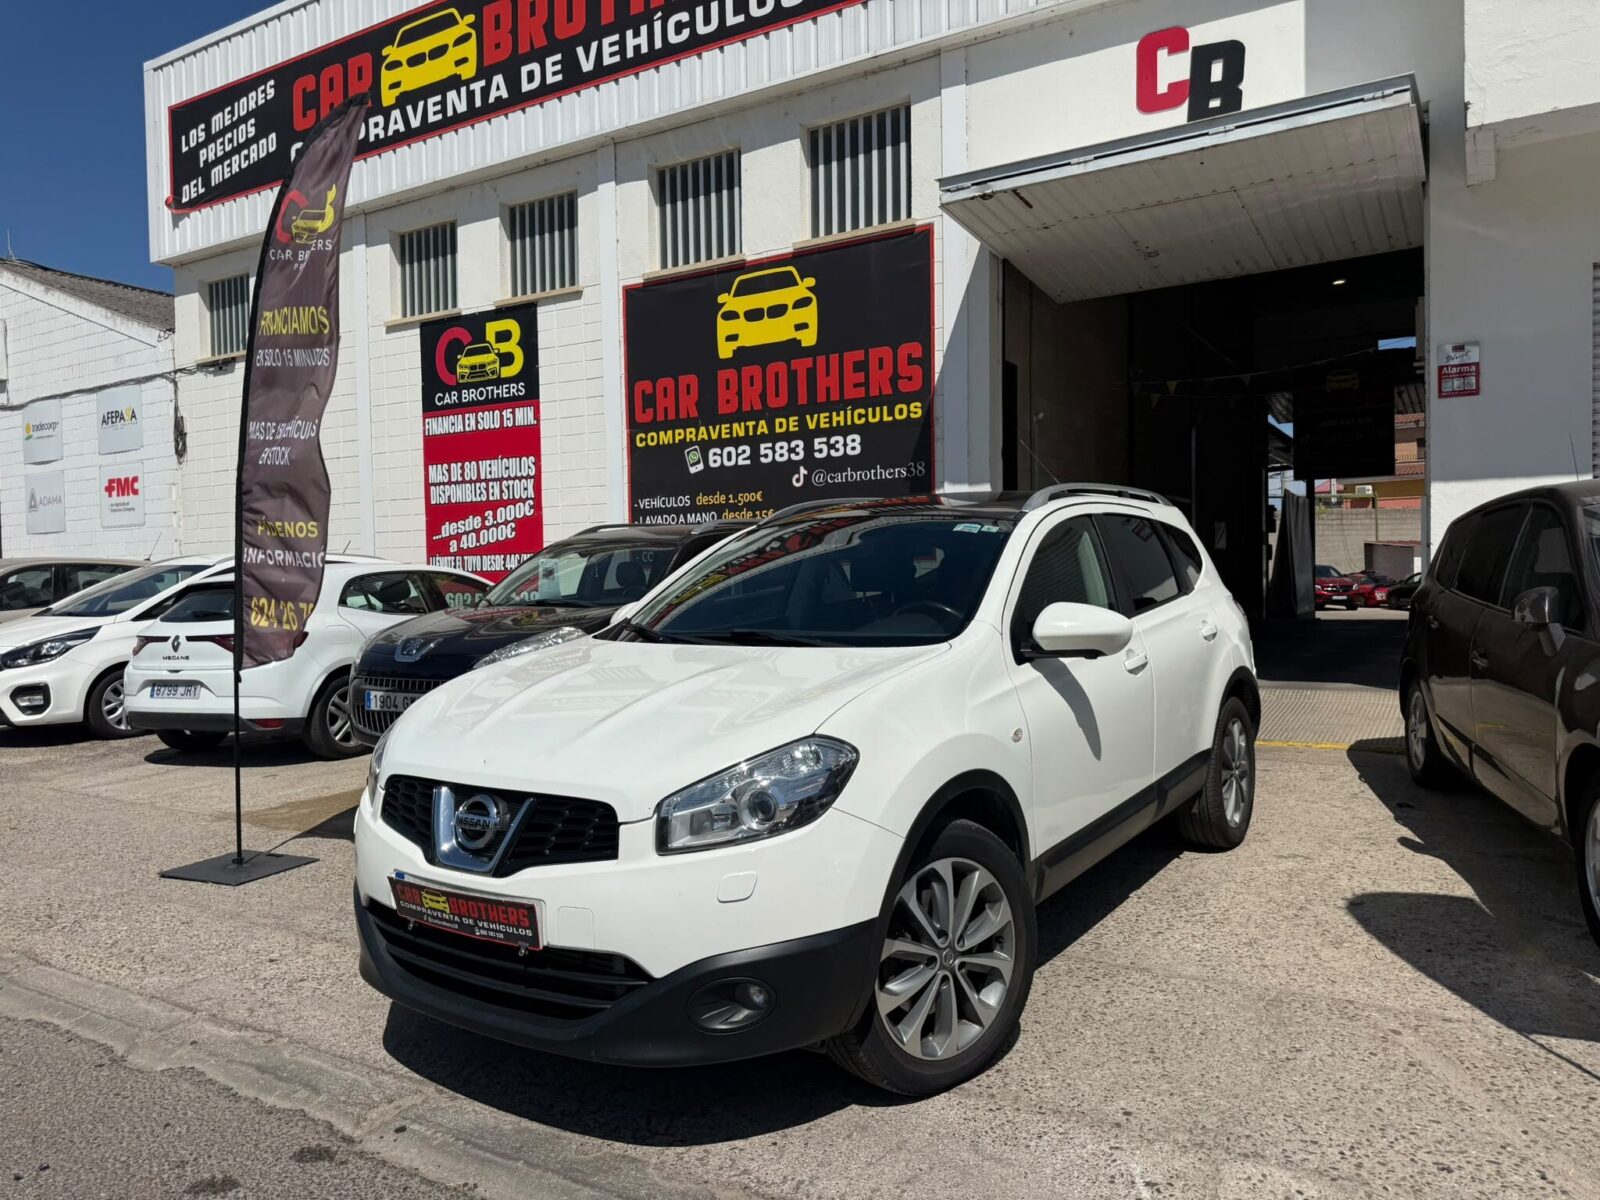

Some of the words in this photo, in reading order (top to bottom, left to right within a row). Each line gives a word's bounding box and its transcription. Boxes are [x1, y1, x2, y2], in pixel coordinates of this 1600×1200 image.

[521, 53, 563, 93] DE
[576, 0, 801, 73] VEHÍCULO
[293, 52, 373, 131] CAR
[483, 0, 665, 67] BRO
[1136, 25, 1246, 122] CB
[181, 127, 205, 153] LOS
[211, 79, 275, 134] MEJORES
[199, 118, 256, 168] PRECIOS
[181, 176, 205, 203] DEL
[211, 132, 277, 186] MERCADO
[269, 249, 293, 260] CAR
[283, 348, 293, 367] 15
[293, 348, 330, 367] MINUTOS
[435, 318, 524, 386] CB
[435, 391, 458, 406] CAR
[462, 382, 525, 402] BROTHERS
[634, 374, 699, 423] CAR
[717, 342, 923, 415] BROTHERS
[249, 421, 265, 440] MAS
[425, 414, 463, 436] FINANCIA
[465, 413, 476, 431] EN
[477, 410, 500, 430] SOLO
[502, 408, 513, 428] 15
[515, 406, 537, 427] MIN.
[635, 419, 768, 448] COMPRAVENTA
[775, 416, 799, 434] DE
[806, 402, 923, 430] VEHÍCULOS
[708, 447, 751, 468] 602
[759, 440, 804, 463] 583
[814, 434, 861, 458] 538
[428, 463, 448, 483] MAS
[451, 462, 462, 482] DE
[464, 461, 477, 480] 80
[479, 455, 535, 479] VEHÍCULOS
[811, 461, 926, 487] @carbrothers38
[105, 476, 139, 498] FMC
[430, 482, 486, 504] DISPONIBLES
[488, 481, 500, 501] EN
[502, 479, 534, 500] STOCK
[639, 495, 691, 509] VEHÍCULOS
[696, 490, 726, 505] desde
[728, 491, 763, 506] 1.500€
[484, 500, 534, 526] 3.000€
[679, 513, 685, 524] A
[687, 511, 717, 524] MANO
[722, 508, 752, 520] desde
[450, 540, 457, 552] a
[460, 522, 516, 549] 40.000€
[464, 555, 480, 572] TUYO
[482, 554, 504, 571] DESDE
[280, 601, 298, 630] 26
[156, 684, 178, 696] 8799
[180, 684, 197, 696] JRY
[373, 694, 398, 709] 1904
[456, 814, 491, 829] NISSAN
[397, 884, 421, 903] CAR
[449, 897, 529, 927] BROTHERS
[400, 901, 460, 922] COMPRAVENTA
[463, 917, 475, 926] DE
[477, 920, 533, 937] VEHÍCULOS
